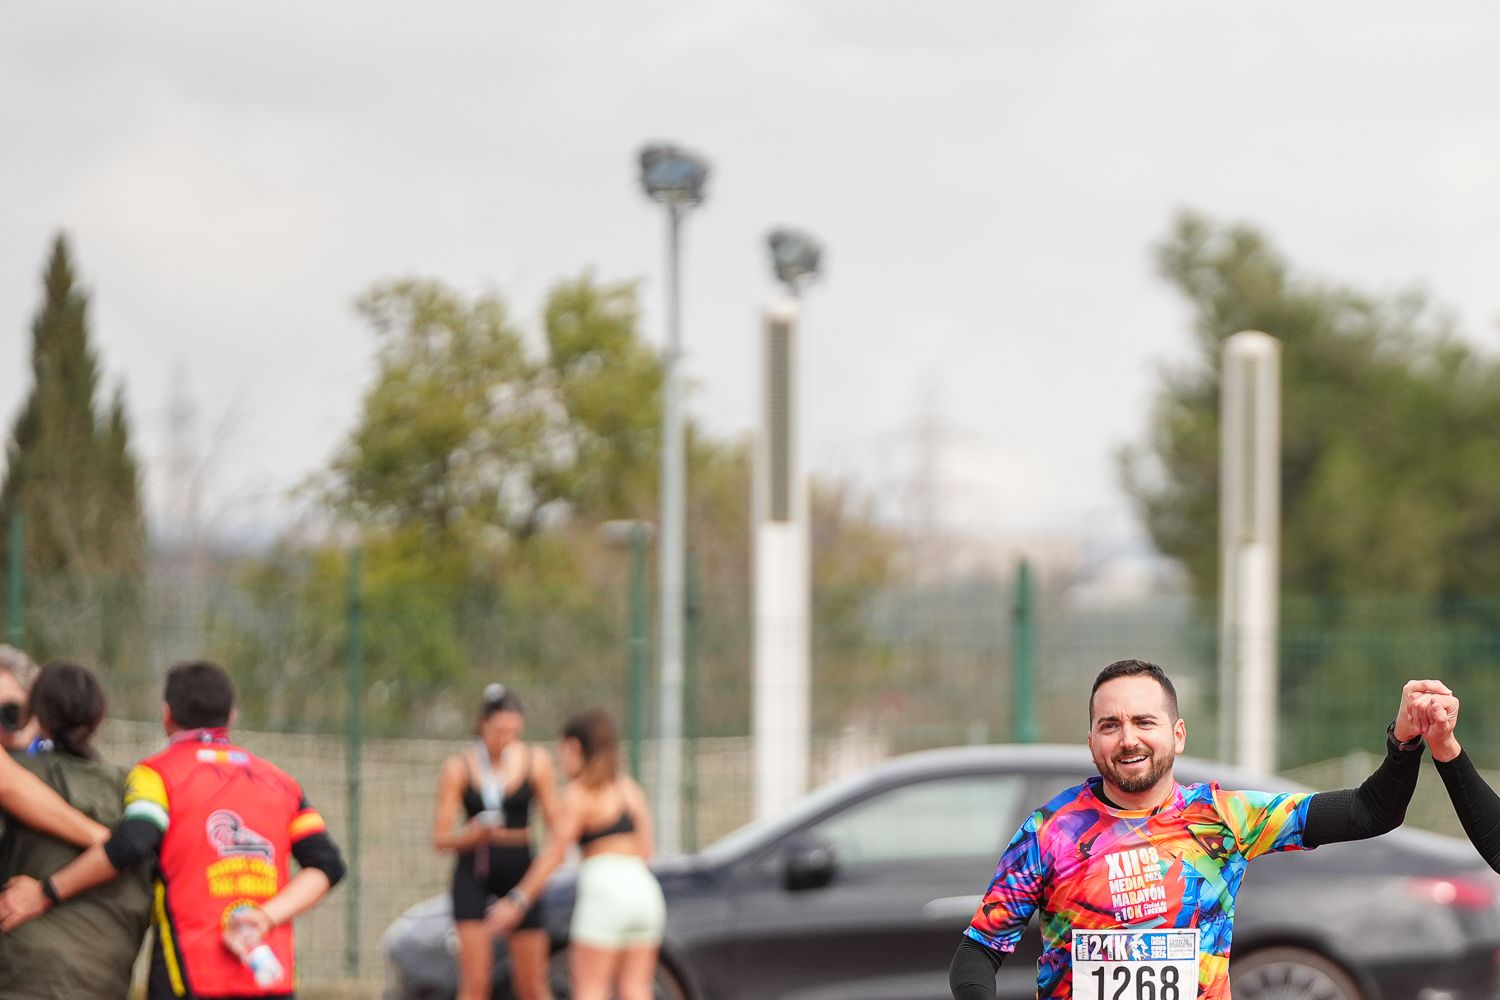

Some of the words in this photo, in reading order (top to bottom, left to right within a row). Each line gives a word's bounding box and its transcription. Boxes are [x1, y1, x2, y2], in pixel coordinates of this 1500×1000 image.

[1104, 850, 1141, 880] XII
[1139, 847, 1159, 864] 08
[1109, 876, 1146, 894] MEDIA
[1112, 884, 1166, 908] MARATÓN
[1121, 905, 1143, 920] 10K
[1090, 934, 1128, 960] 21K
